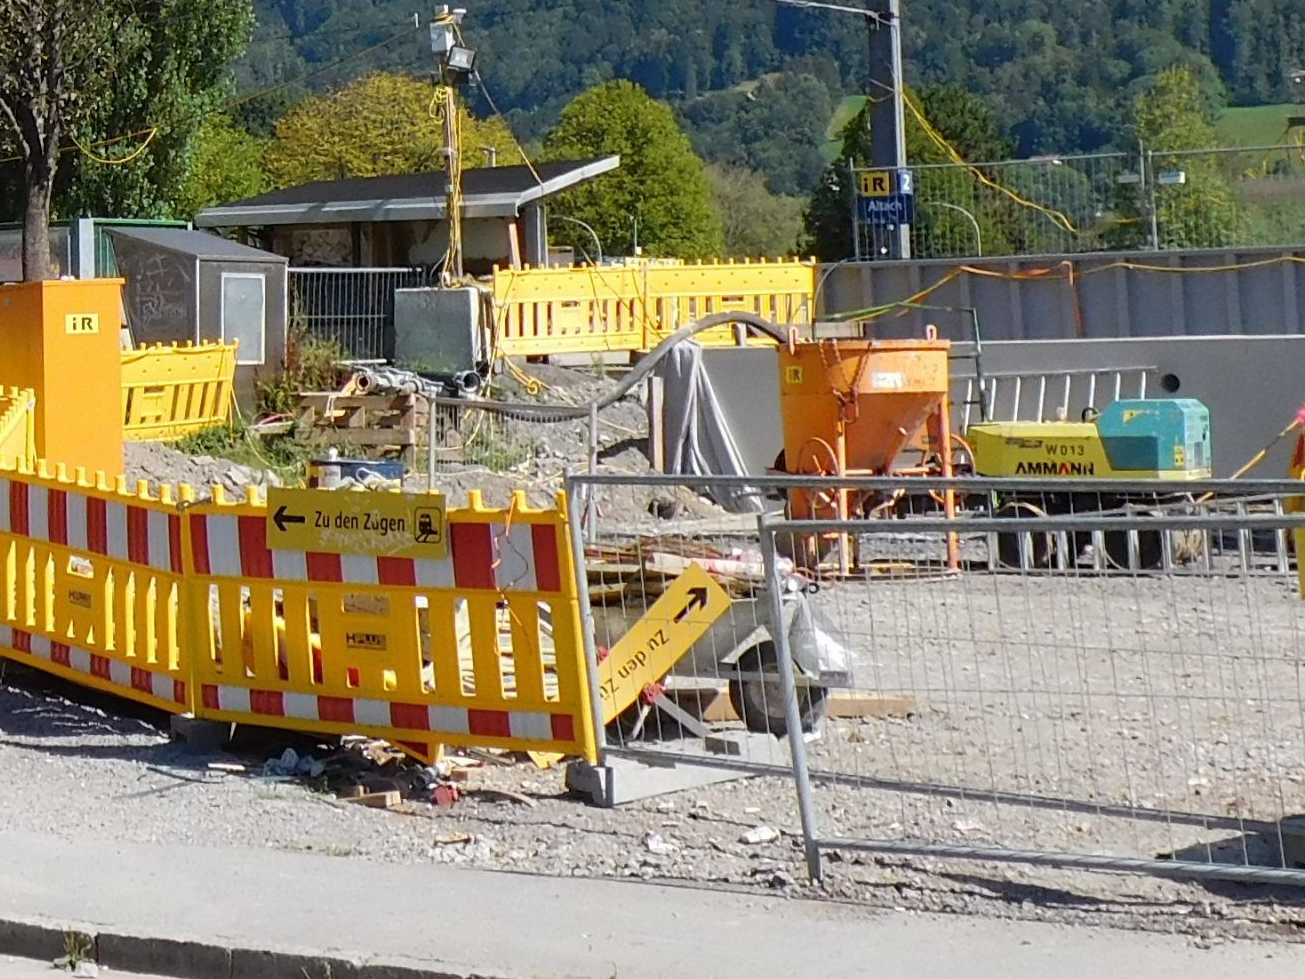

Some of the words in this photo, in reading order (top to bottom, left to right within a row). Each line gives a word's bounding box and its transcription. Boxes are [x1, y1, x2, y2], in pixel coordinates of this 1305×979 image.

[902, 174, 911, 191] 2
[868, 200, 903, 212] Altach
[1015, 461, 1094, 476] AMMANN
[314, 511, 330, 528] Zu
[335, 513, 359, 530] den
[648, 629, 670, 651] Zu
[618, 650, 647, 678] den
